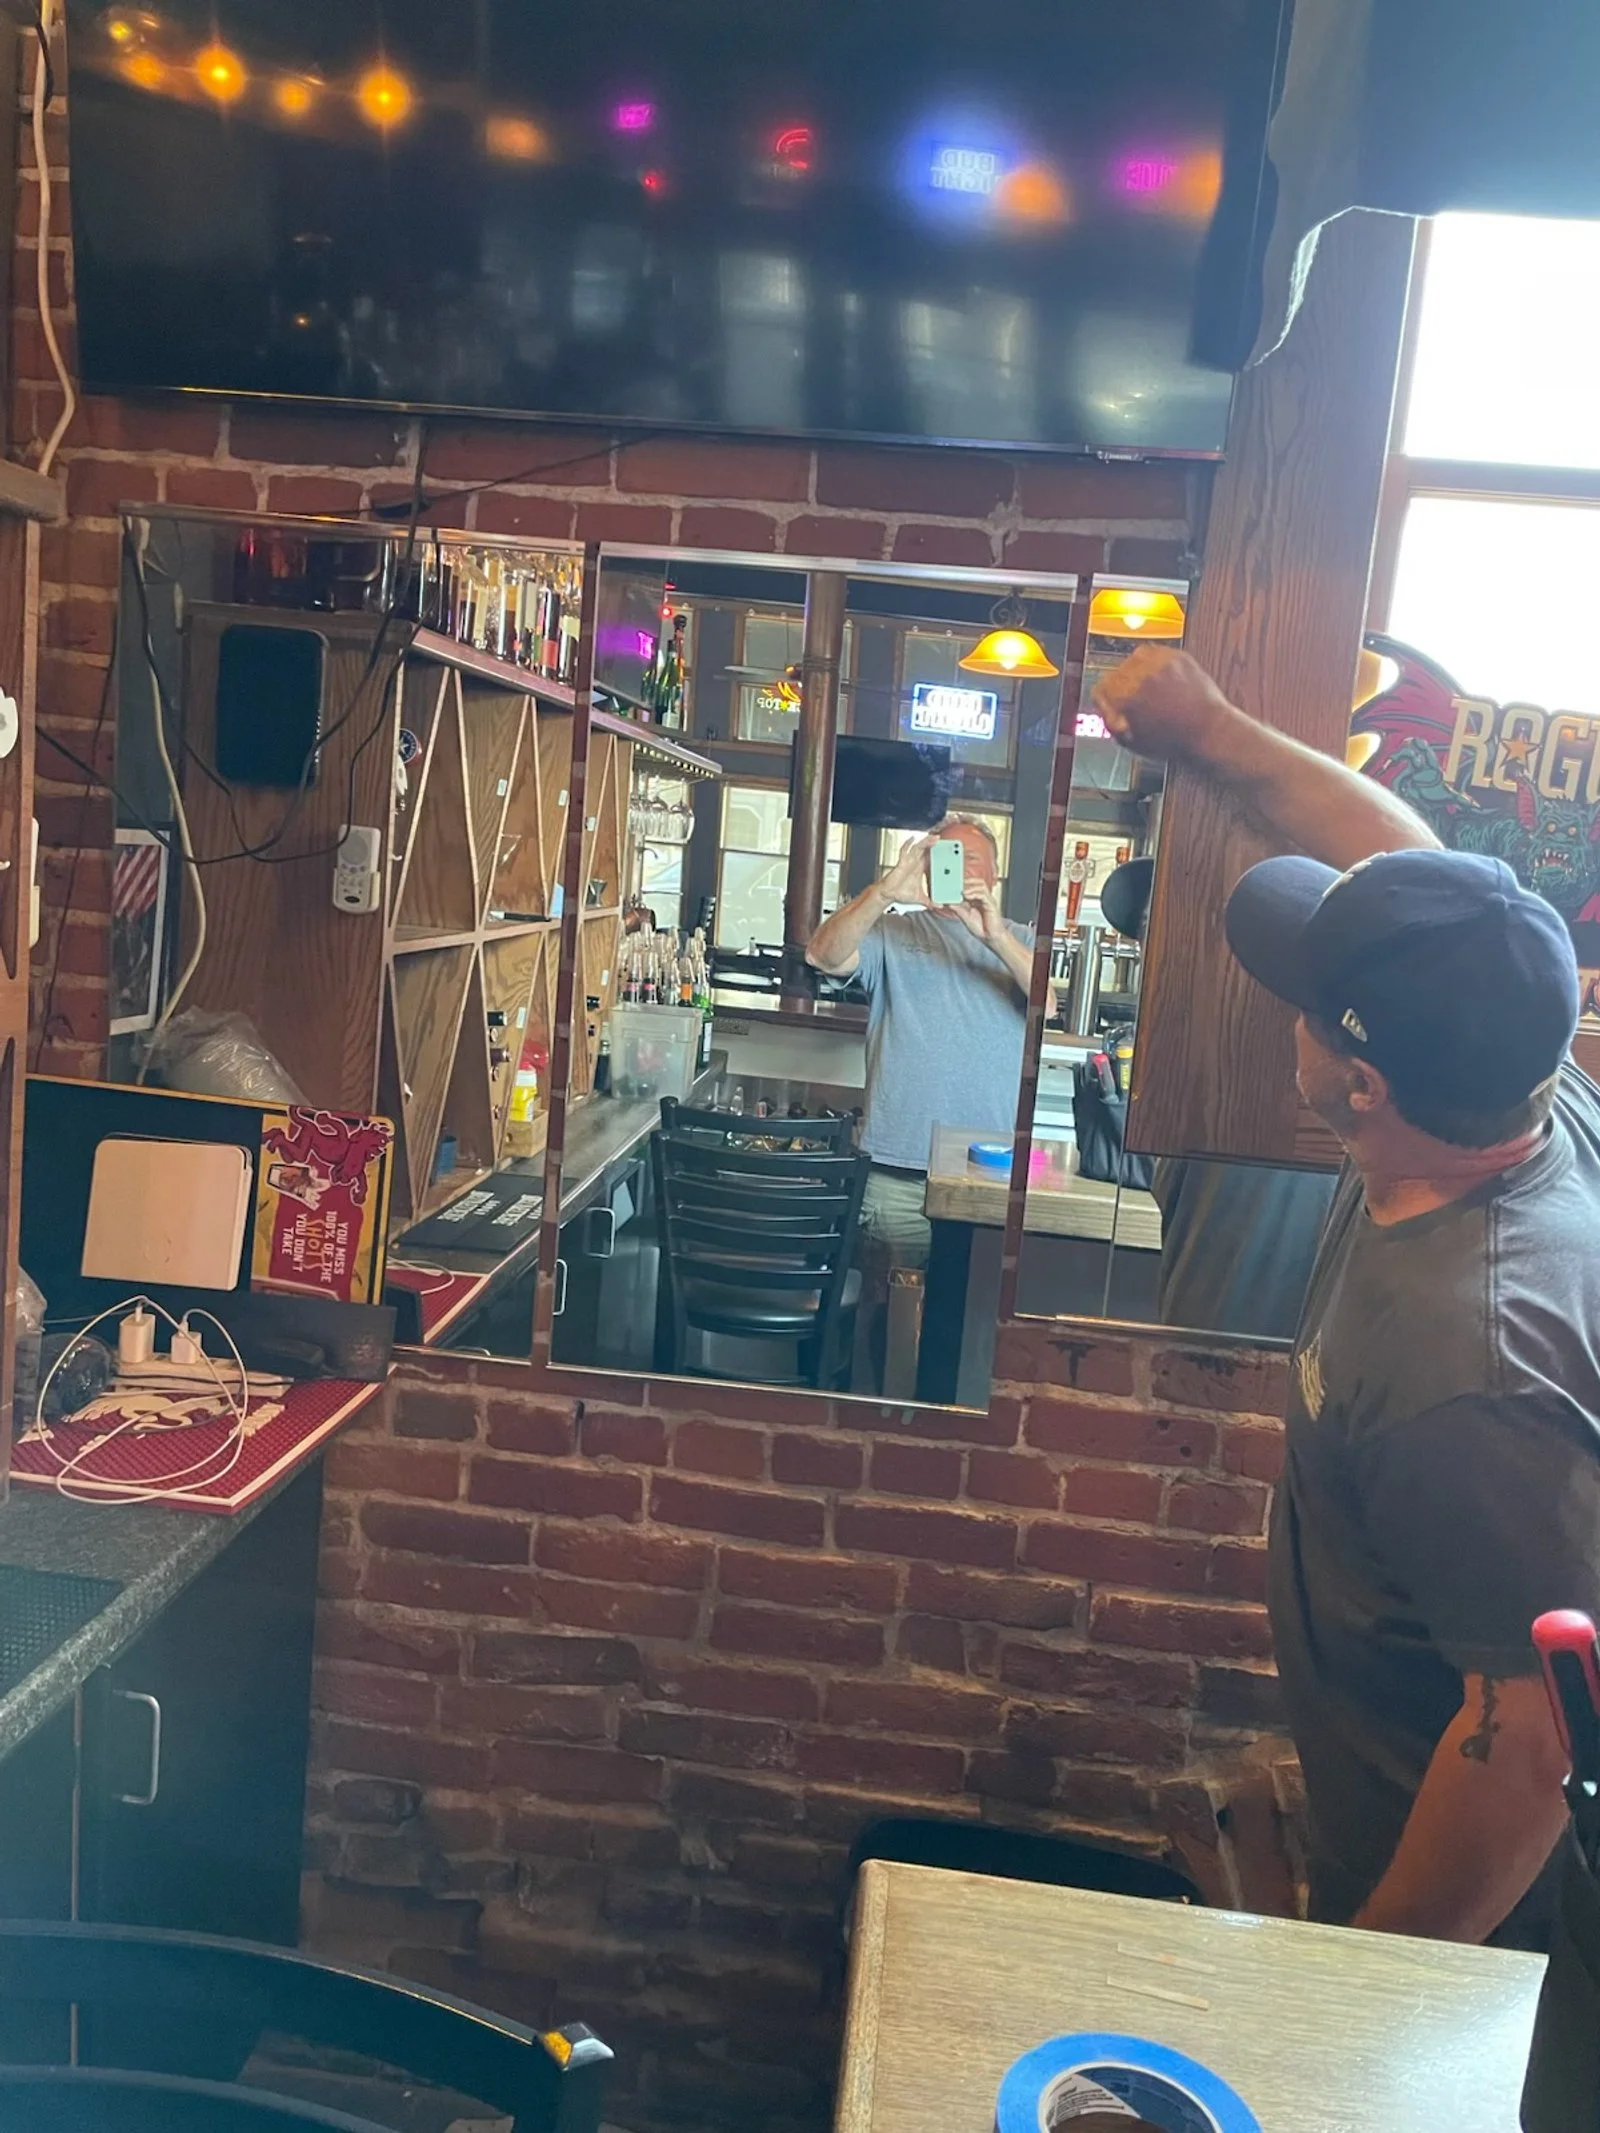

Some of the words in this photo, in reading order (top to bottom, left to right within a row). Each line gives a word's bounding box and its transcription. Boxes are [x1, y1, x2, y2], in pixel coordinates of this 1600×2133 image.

[296, 1213, 307, 1236] YOU
[325, 1211, 337, 1239] 100%
[336, 1222, 348, 1245] YOU
[282, 1227, 293, 1255] TAKE
[303, 1218, 326, 1270] SHOTS
[324, 1243, 335, 1258] OF
[293, 1239, 304, 1272] DON'T
[334, 1247, 346, 1275] MISS
[320, 1261, 333, 1284] THE
